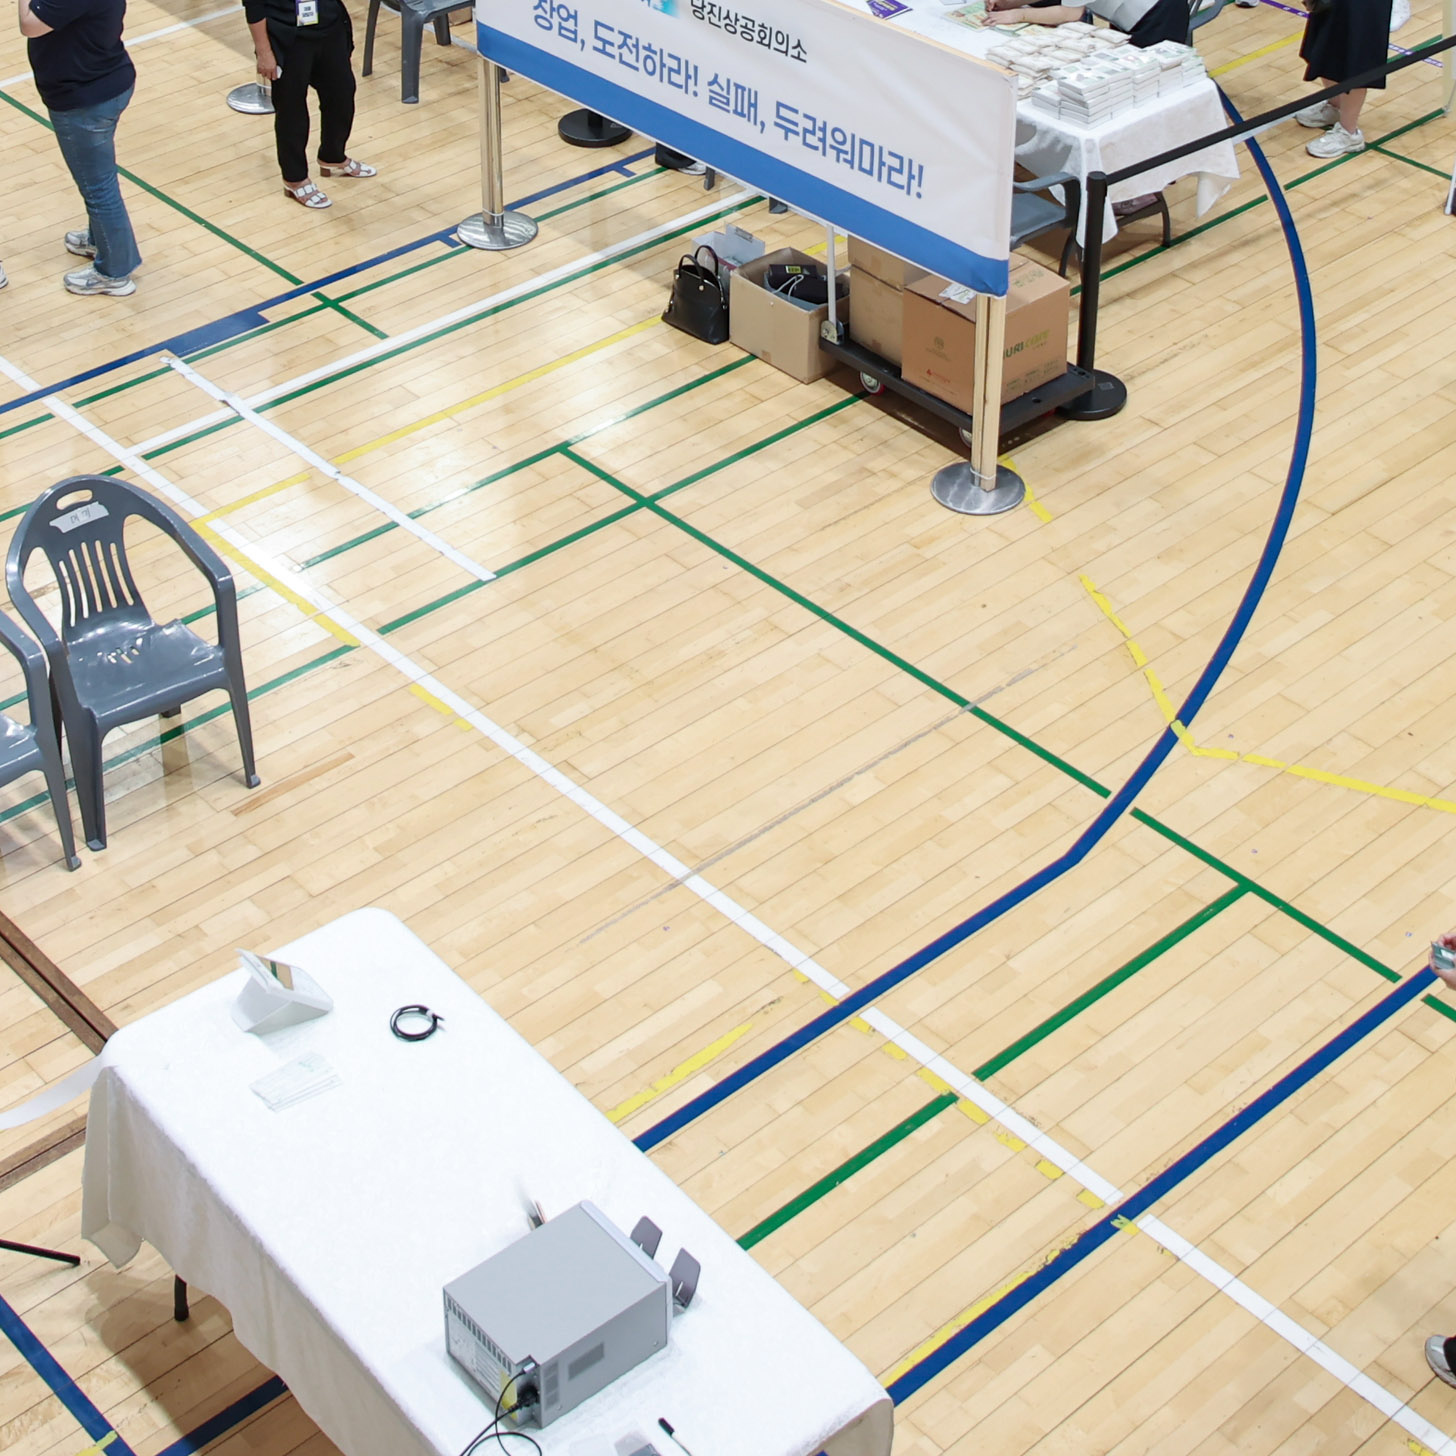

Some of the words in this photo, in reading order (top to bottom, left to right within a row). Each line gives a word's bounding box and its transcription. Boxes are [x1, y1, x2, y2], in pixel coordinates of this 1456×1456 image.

[592, 17, 699, 97] 도전하라!
[707, 71, 766, 134] 실패,
[773, 100, 925, 199] 두려워마라!
